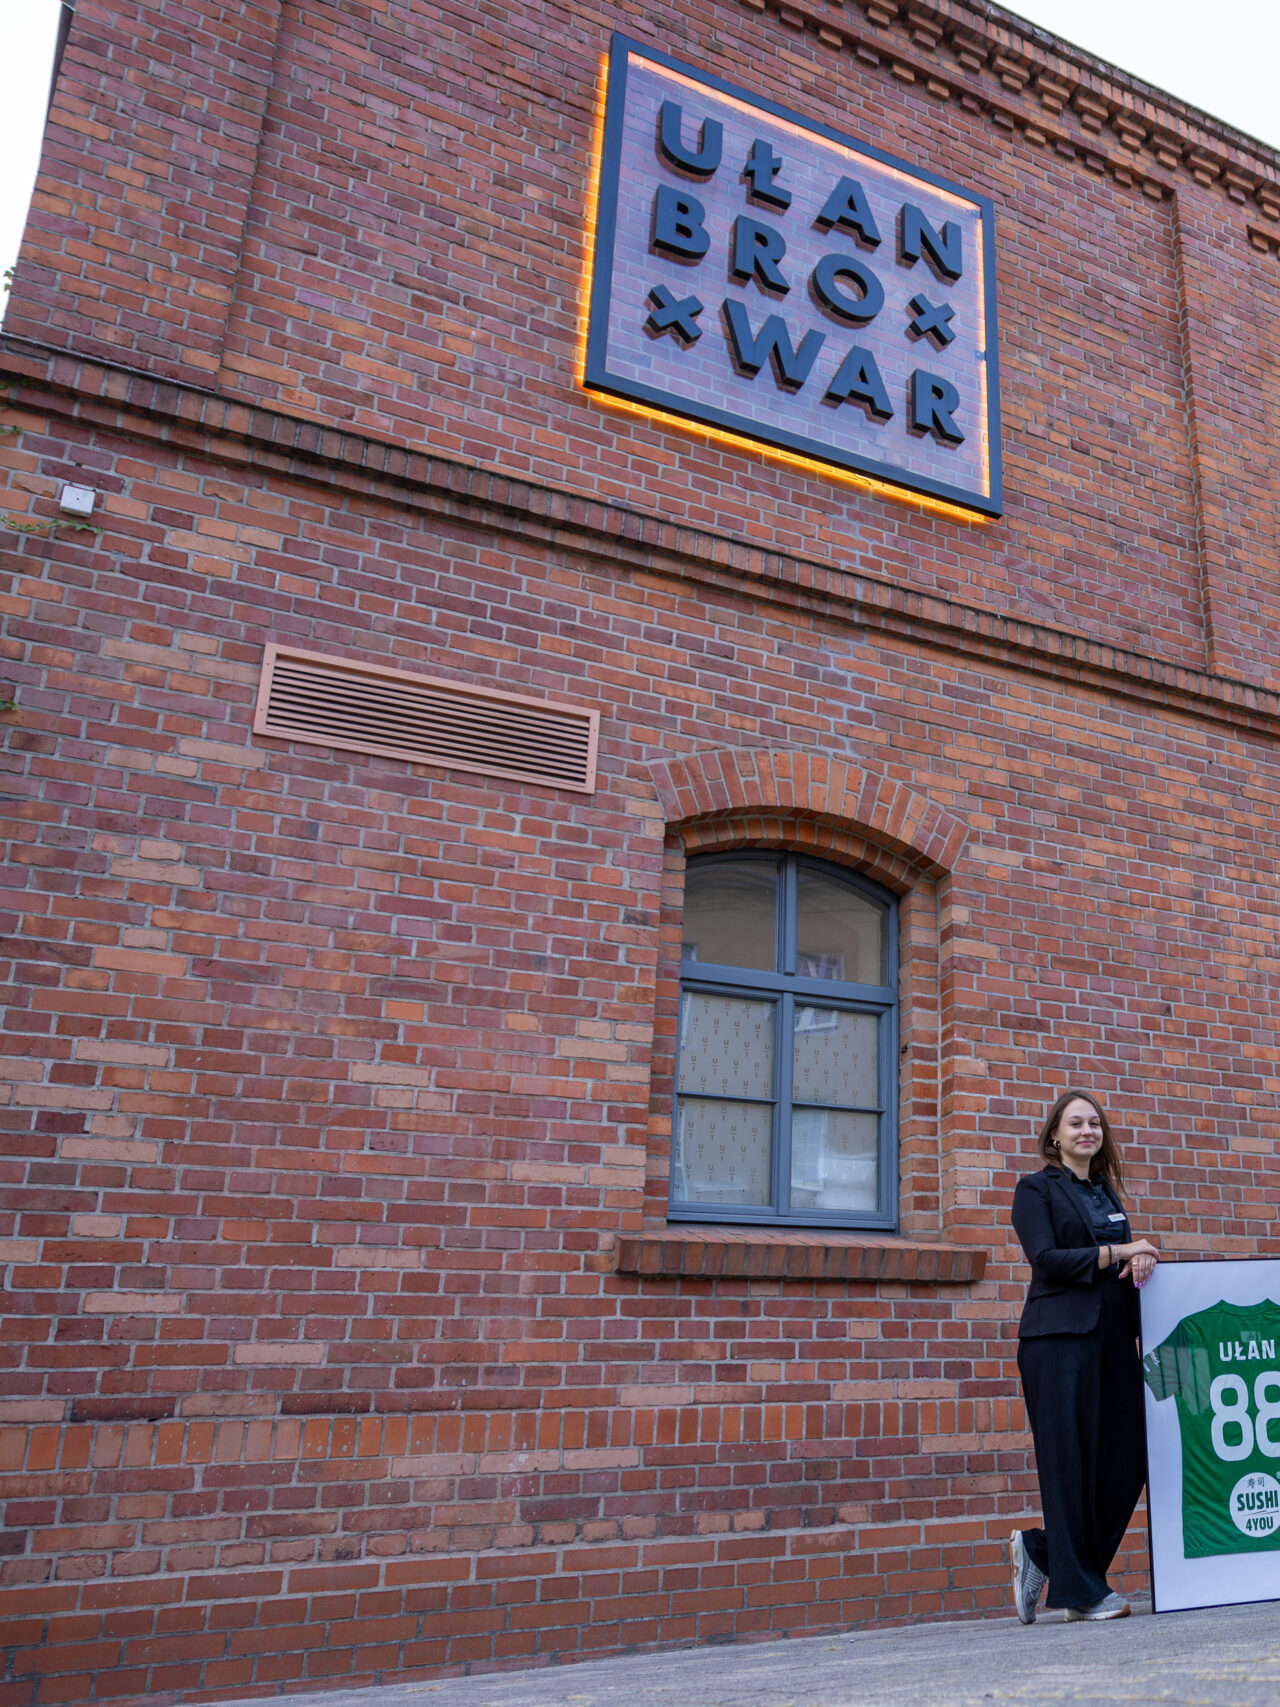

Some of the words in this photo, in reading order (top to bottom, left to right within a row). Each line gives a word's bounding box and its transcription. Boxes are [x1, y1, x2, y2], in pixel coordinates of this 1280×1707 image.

[659, 100, 963, 281] UŁAN
[1219, 1339, 1276, 1361] UŁAN
[1236, 1490, 1279, 1511] SUSHI
[1246, 1516, 1274, 1531] 4YOU
